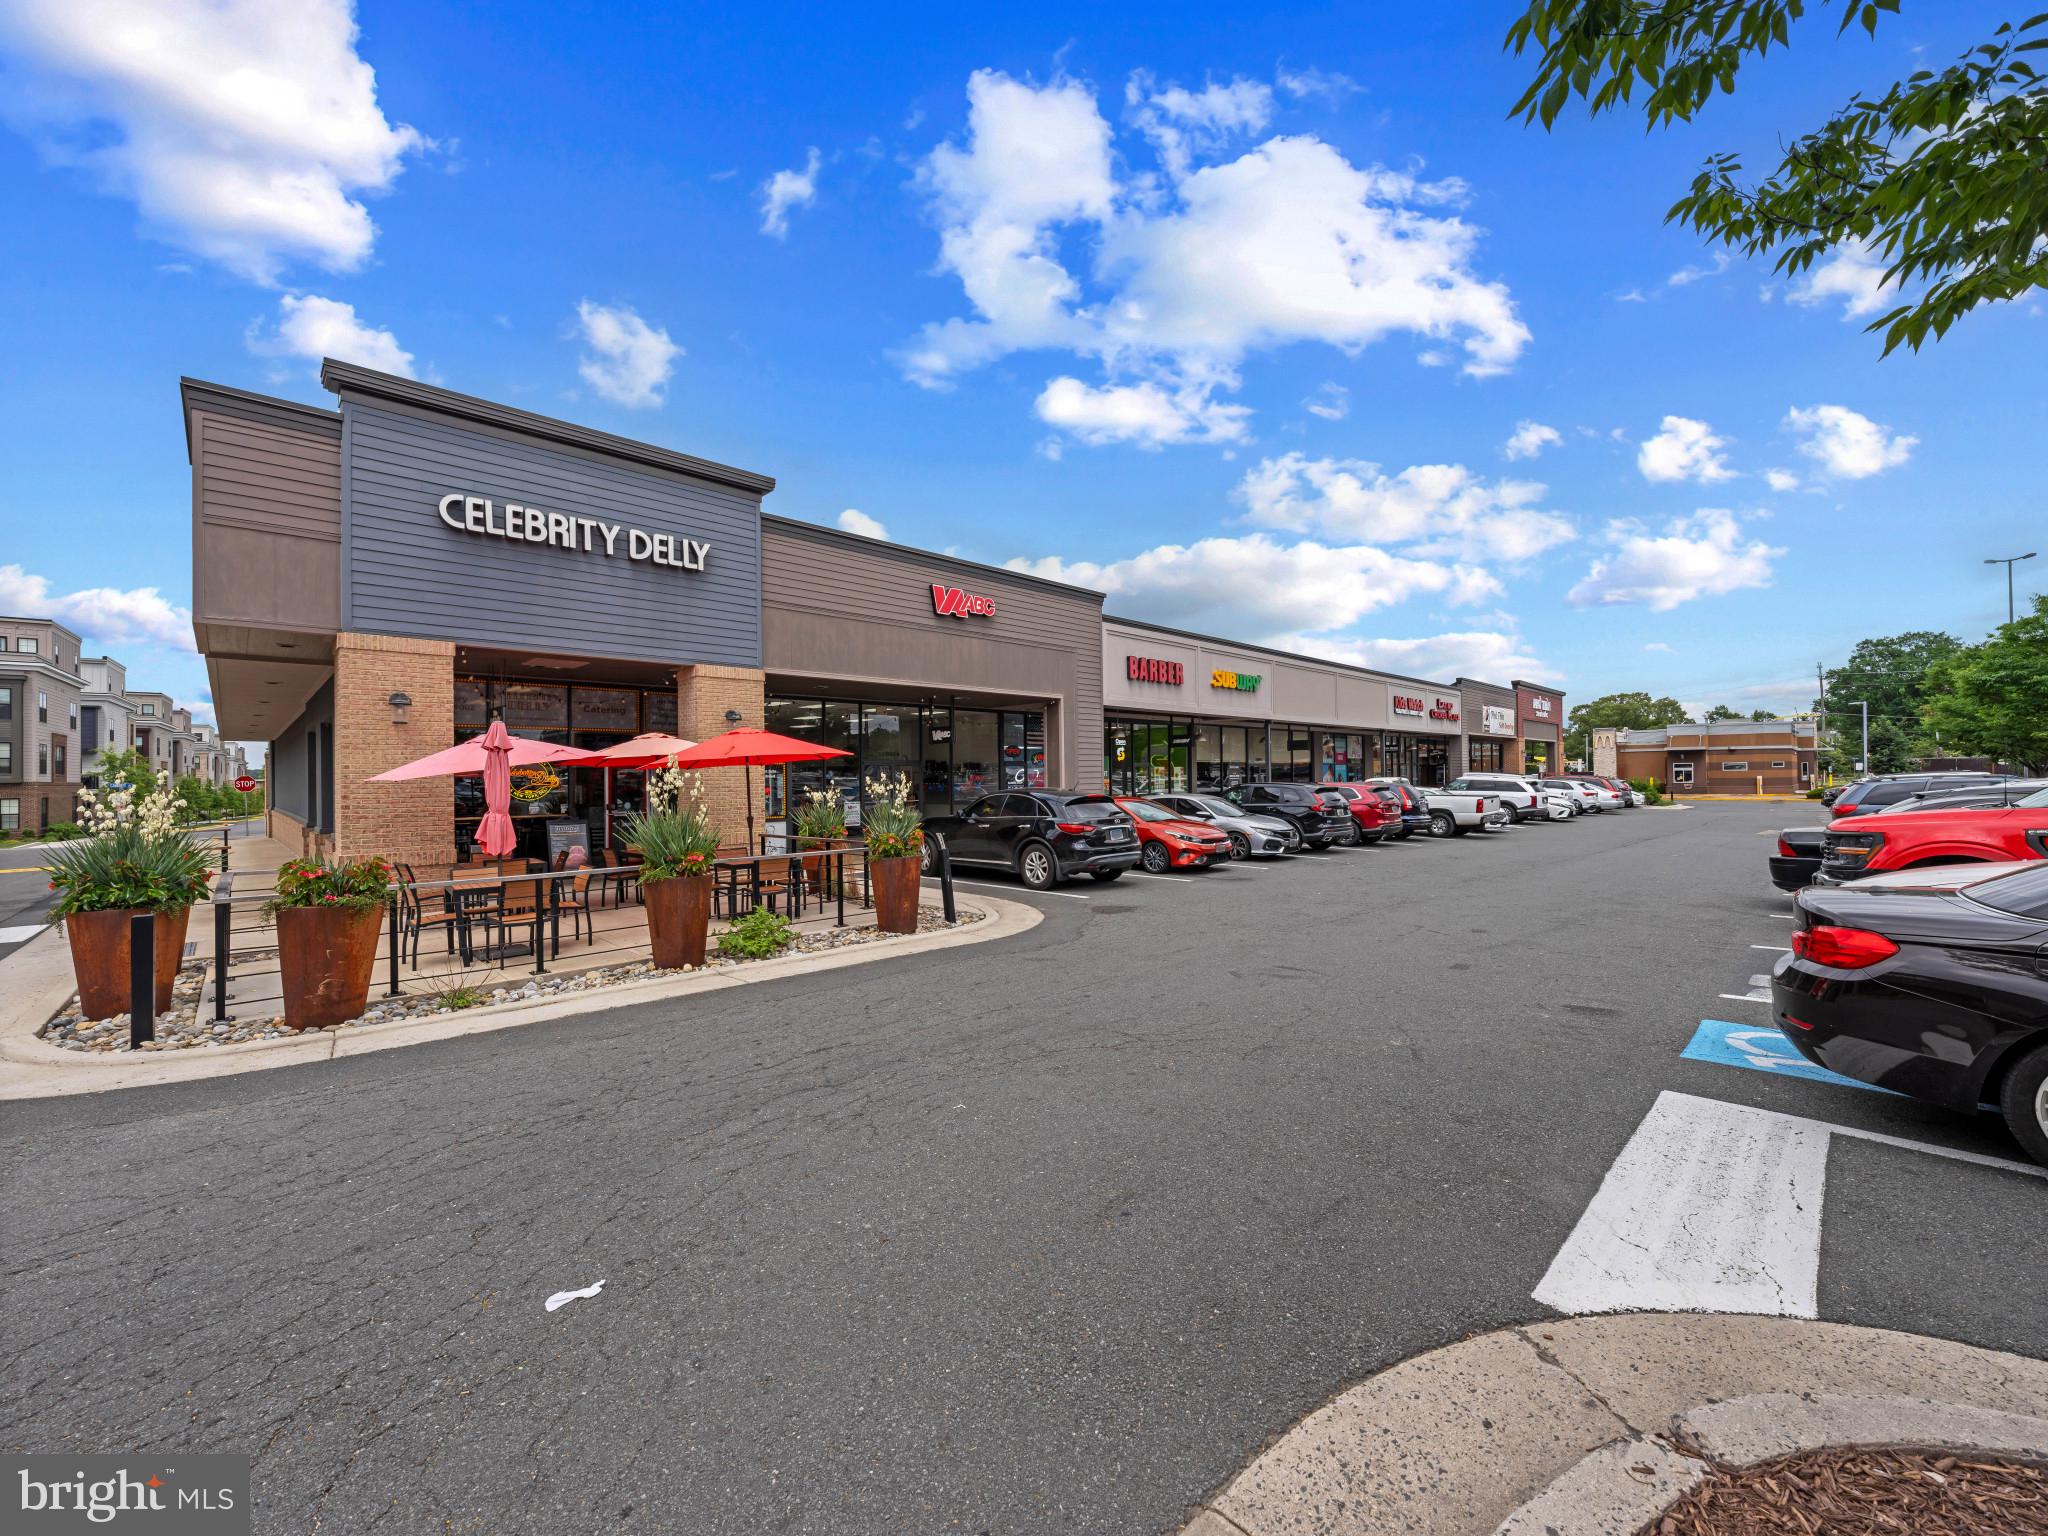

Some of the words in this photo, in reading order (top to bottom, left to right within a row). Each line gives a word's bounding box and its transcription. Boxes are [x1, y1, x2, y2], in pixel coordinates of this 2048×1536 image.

[439, 494, 620, 555] CELEBRITY
[629, 528, 711, 571] DELLY
[959, 594, 996, 617] ABC
[1127, 656, 1184, 686] BARBER
[1211, 669, 1262, 693] SUBWAY
[583, 704, 626, 716] Catering
[235, 780, 255, 788] STOP
